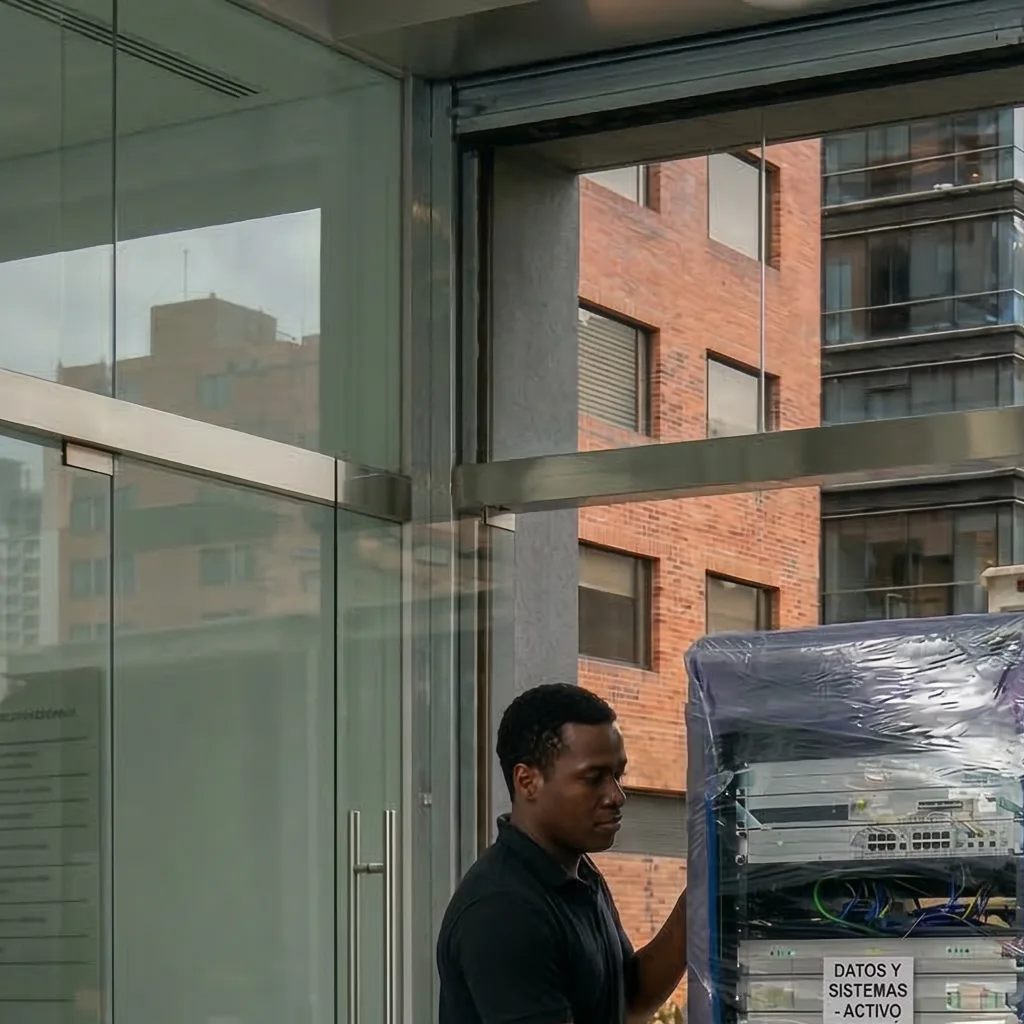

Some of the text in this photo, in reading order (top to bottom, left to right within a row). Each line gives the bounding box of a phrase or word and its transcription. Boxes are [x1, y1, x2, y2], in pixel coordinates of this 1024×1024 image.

[834, 963, 901, 977] DATOS Y
[829, 983, 907, 997] SISTEMAS
[843, 1003, 902, 1018] ACTIVO
